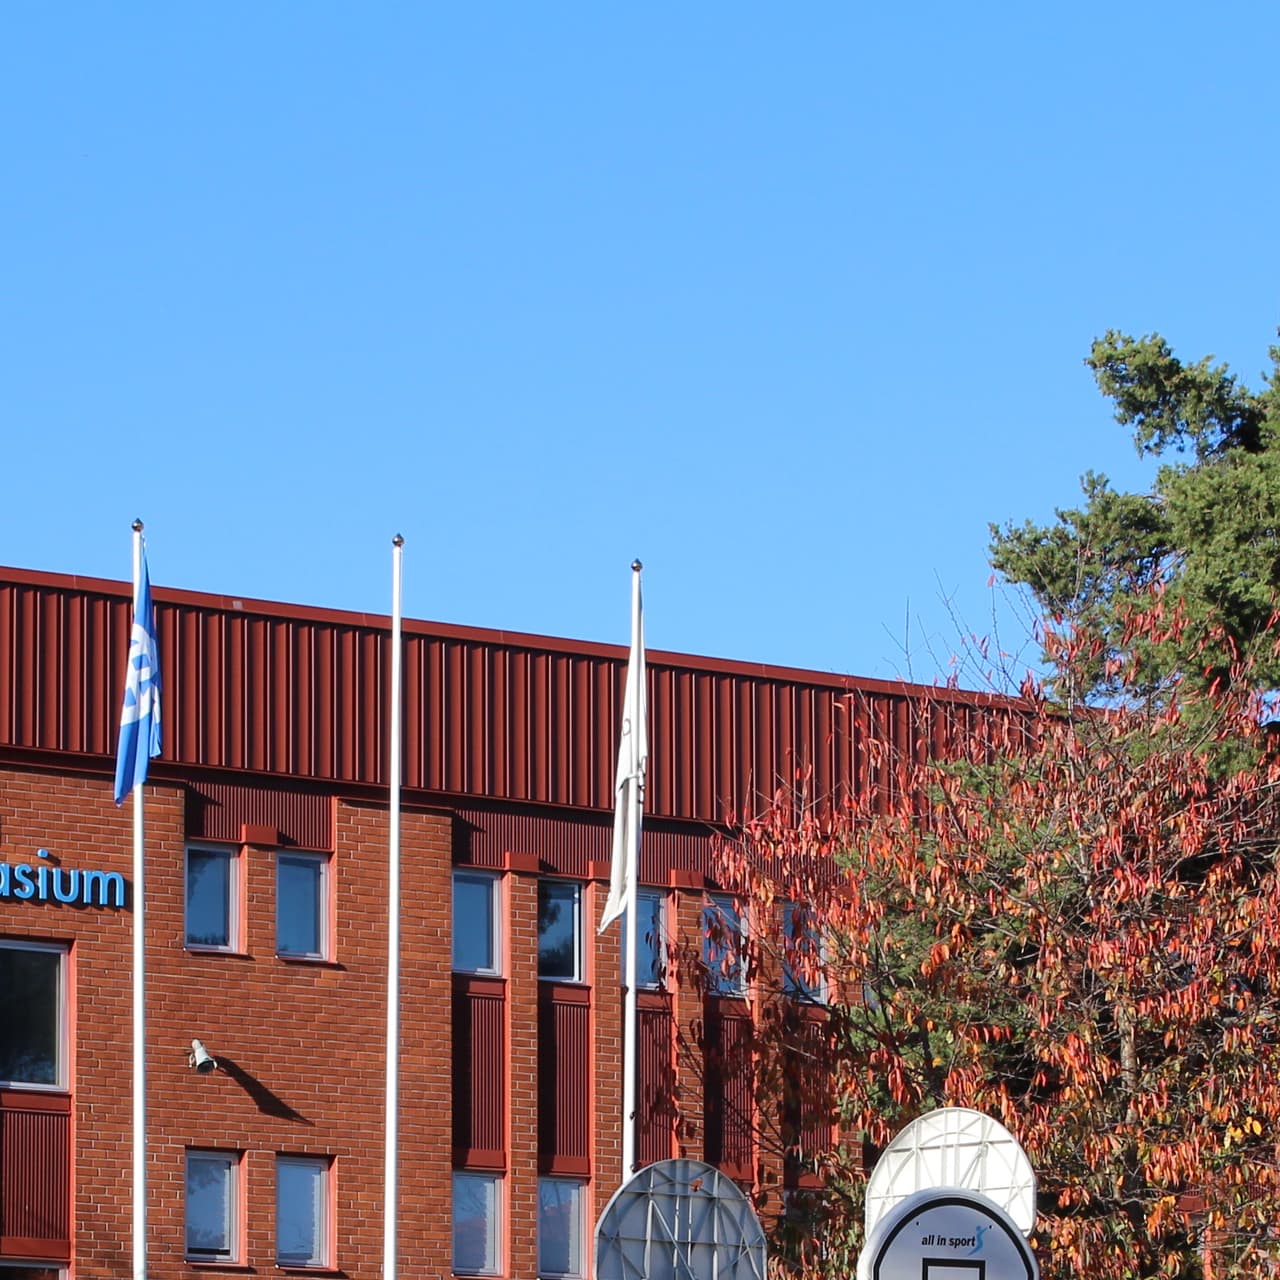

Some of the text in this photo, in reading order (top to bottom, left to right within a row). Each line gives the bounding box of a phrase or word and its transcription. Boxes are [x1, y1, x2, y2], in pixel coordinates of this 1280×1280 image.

[921, 1234, 976, 1249] all in sport
